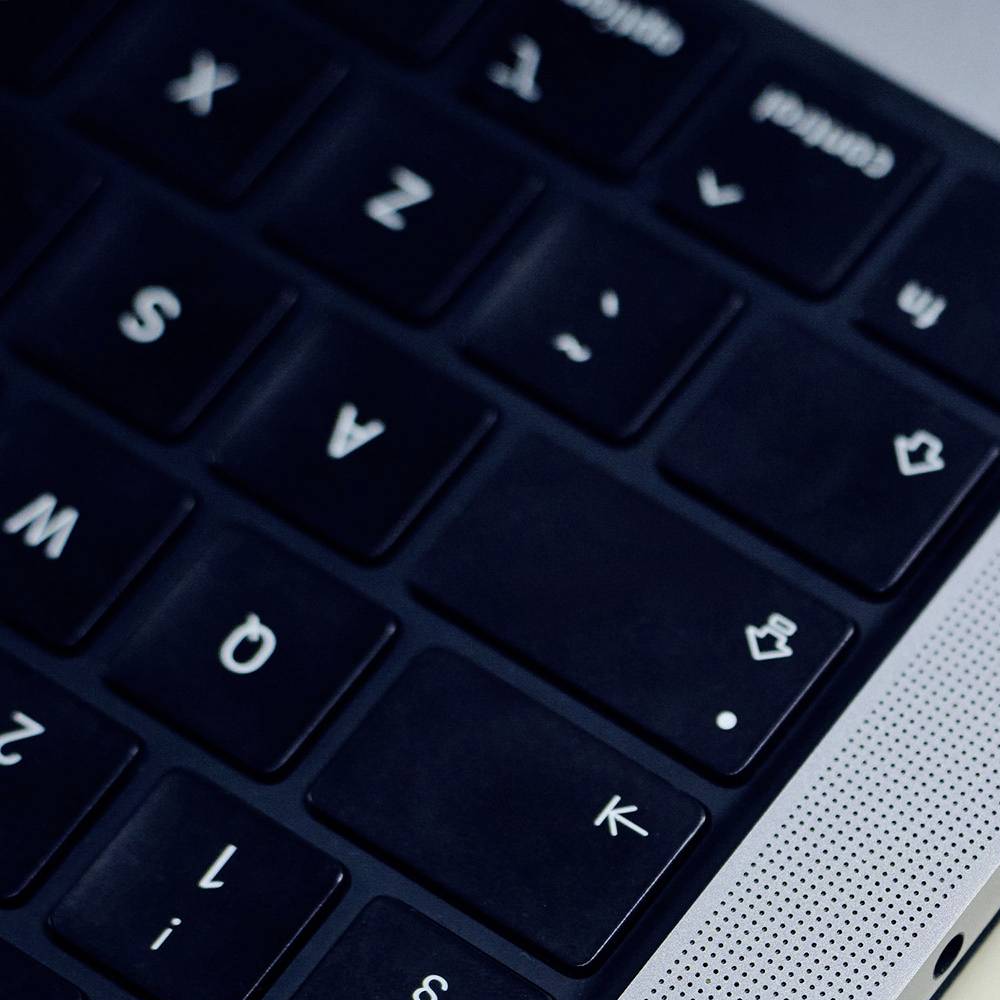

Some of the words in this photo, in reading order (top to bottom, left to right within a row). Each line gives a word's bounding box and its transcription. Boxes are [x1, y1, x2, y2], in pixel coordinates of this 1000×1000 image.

[172, 54, 237, 115] X
[756, 80, 901, 178] control
[367, 169, 433, 230] Z
[119, 287, 181, 343] S
[898, 283, 947, 330] fn
[327, 404, 385, 459] A
[4, 494, 80, 559] W
[219, 613, 277, 675] Q
[0, 711, 45, 766] 2
[198, 844, 238, 890] 1
